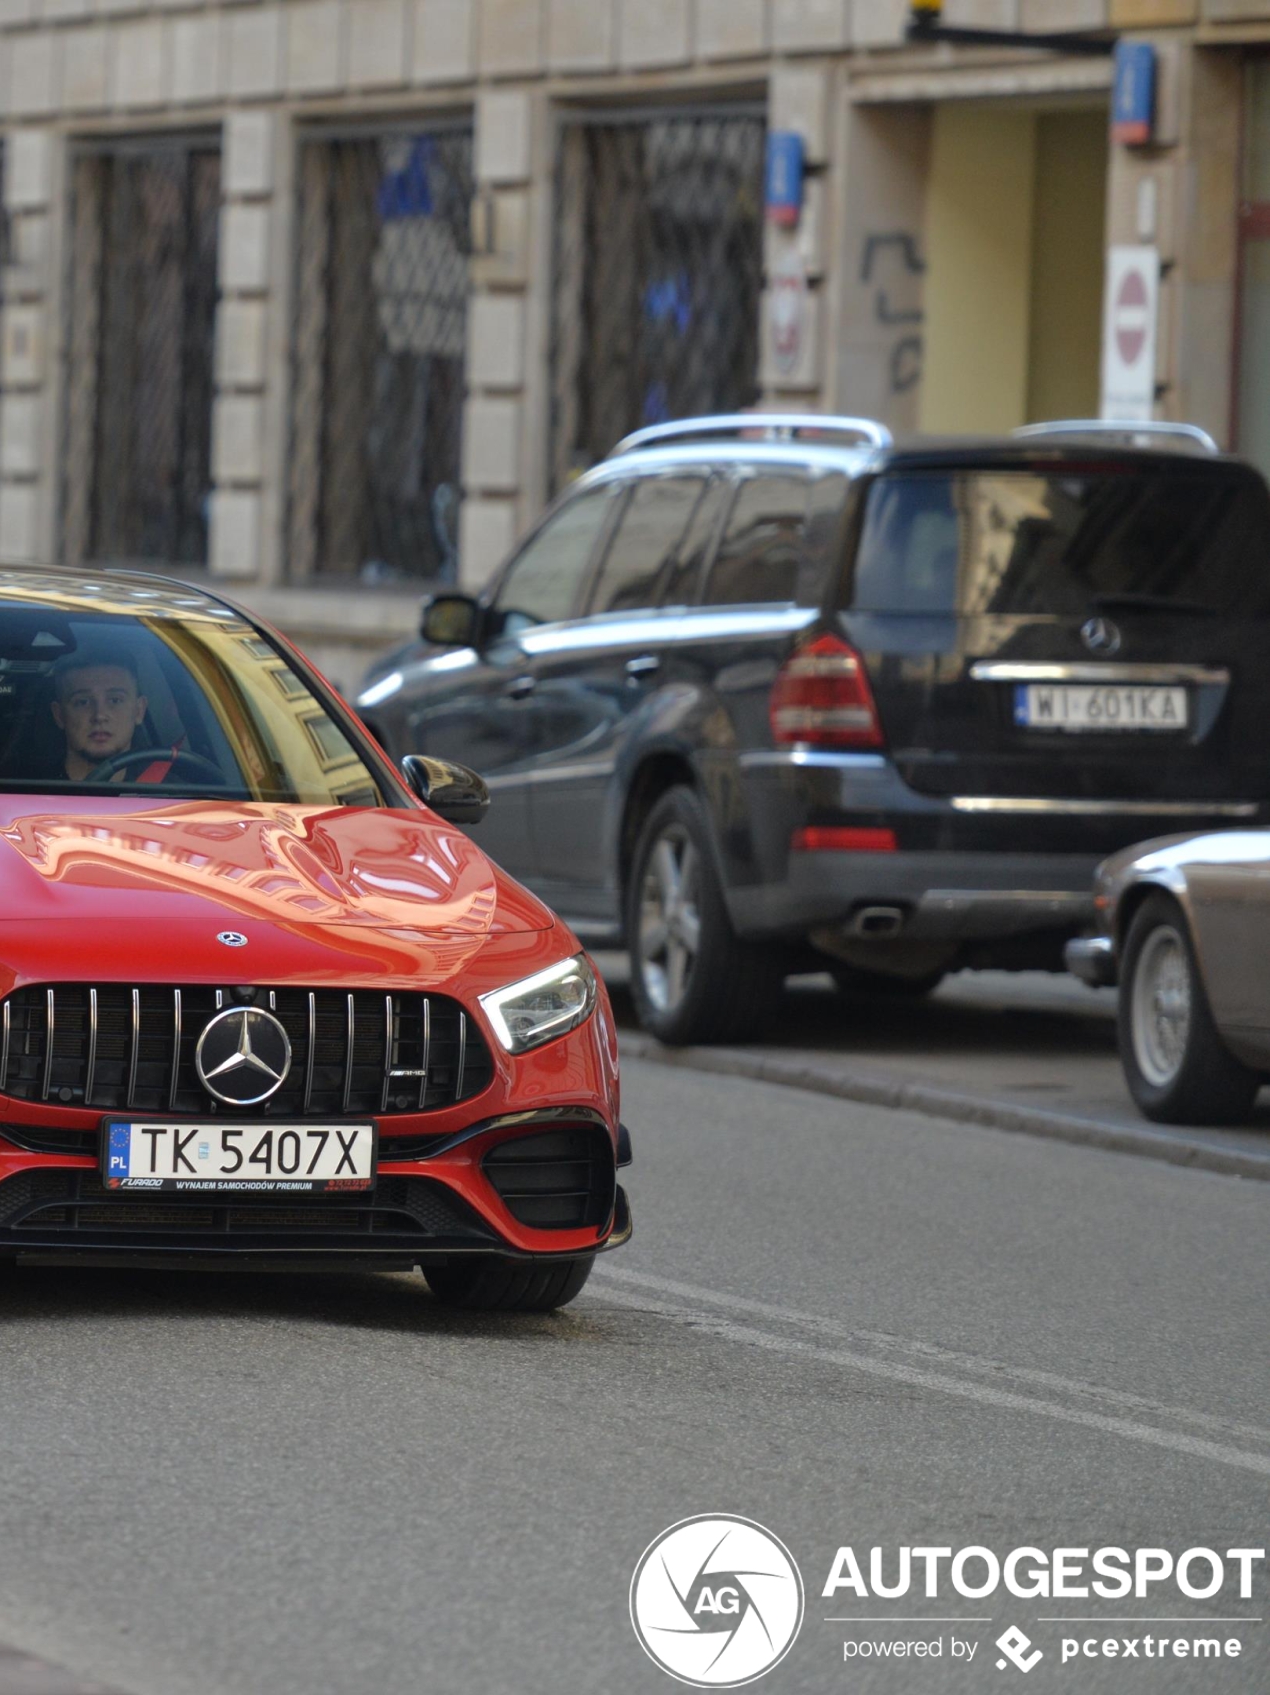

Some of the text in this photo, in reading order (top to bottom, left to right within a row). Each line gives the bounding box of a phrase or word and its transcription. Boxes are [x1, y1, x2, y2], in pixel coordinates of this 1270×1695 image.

[1036, 688, 1177, 719] WI 601KA
[141, 1128, 359, 1174] TK 5407X
[111, 1156, 127, 1169] PL
[121, 1178, 163, 1187] FURADO
[176, 1180, 313, 1190] WYNAJEM SAMOCHODÓW PREMIUM
